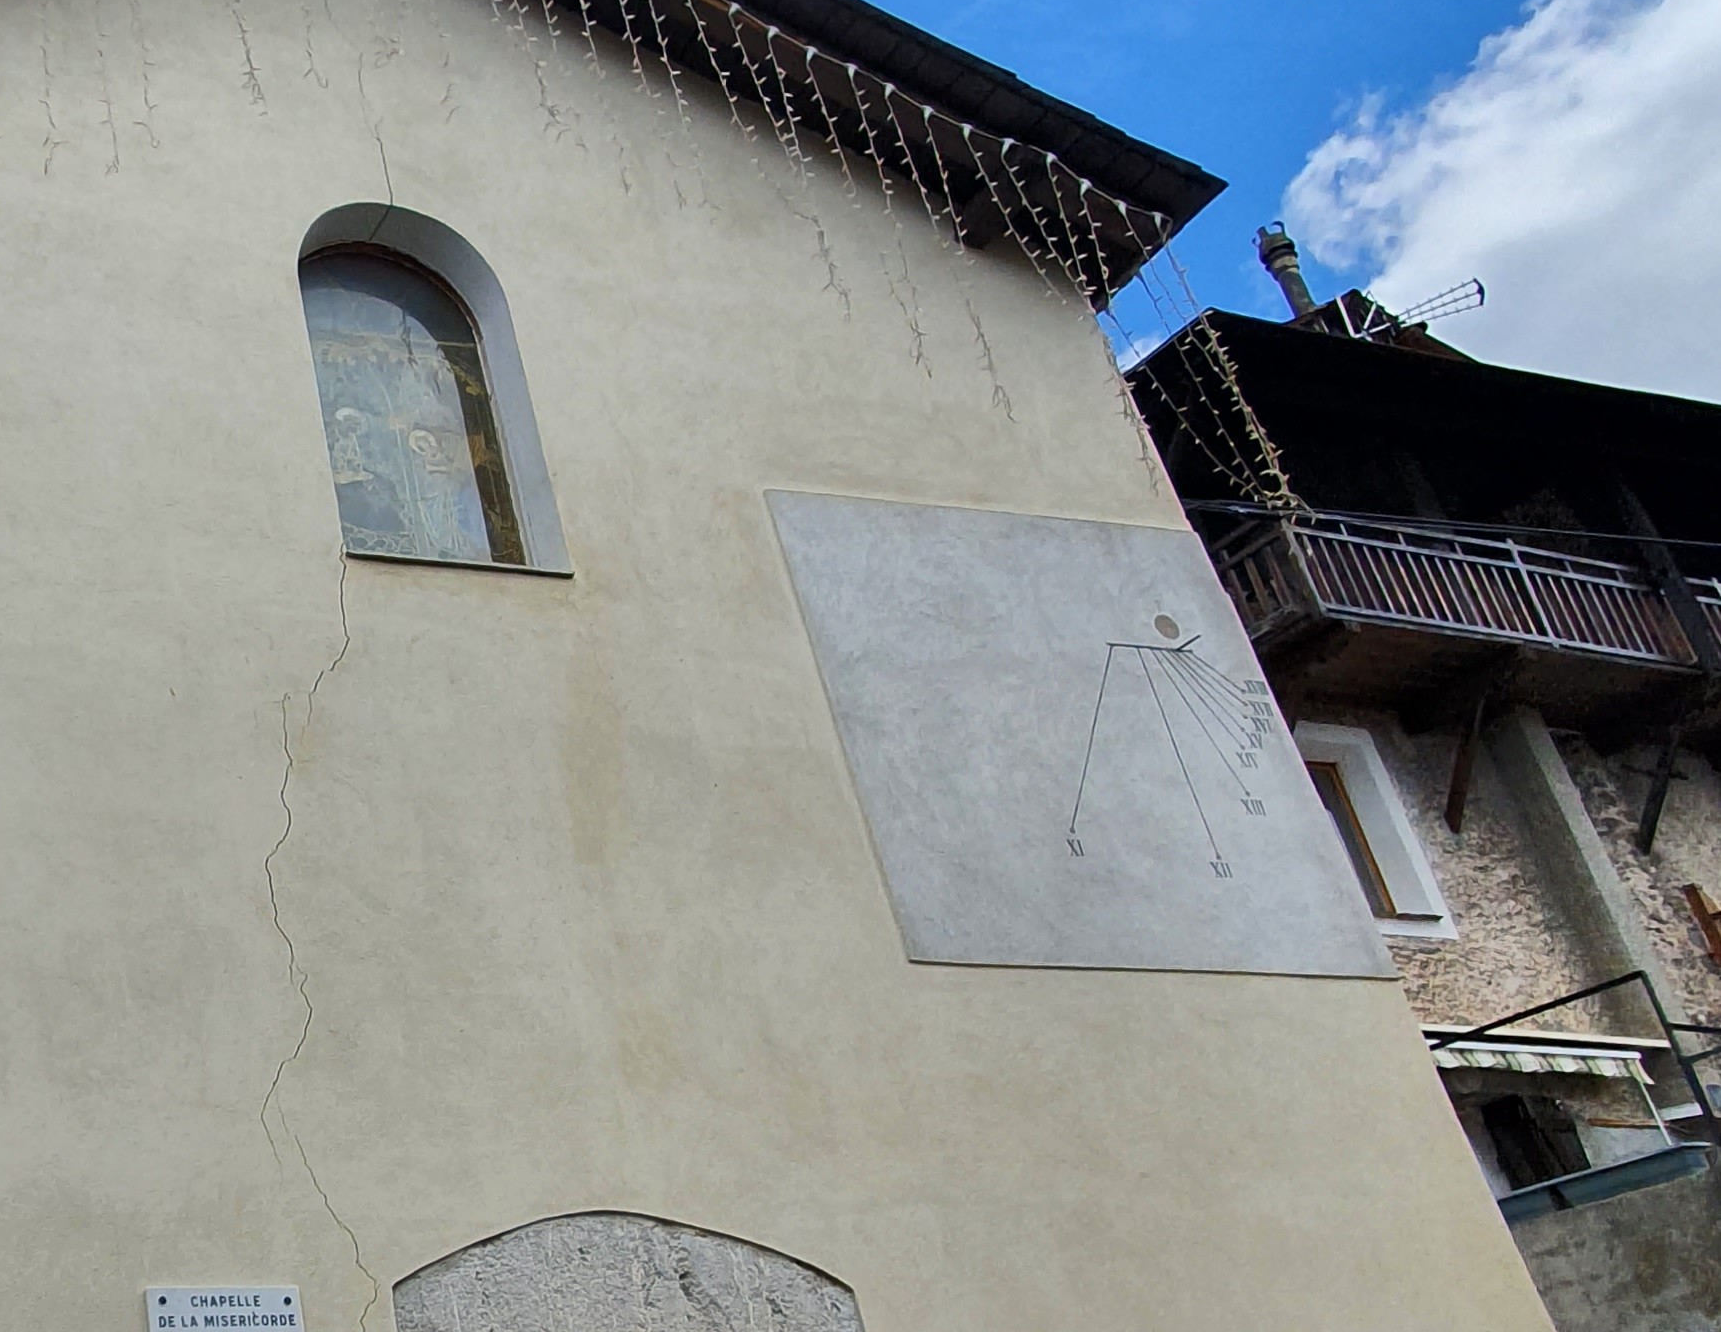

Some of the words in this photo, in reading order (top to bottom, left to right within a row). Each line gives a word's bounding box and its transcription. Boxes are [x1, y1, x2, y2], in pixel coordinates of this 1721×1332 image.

[1245, 731, 1263, 749] XV
[1240, 798, 1266, 817] XIII
[1066, 838, 1085, 857] XI
[1210, 861, 1233, 878] XII
[190, 1295, 261, 1307] CHAPELLE
[158, 1315, 176, 1328] DE
[181, 1315, 199, 1328] LA
[204, 1313, 297, 1328] MISERICORDE
